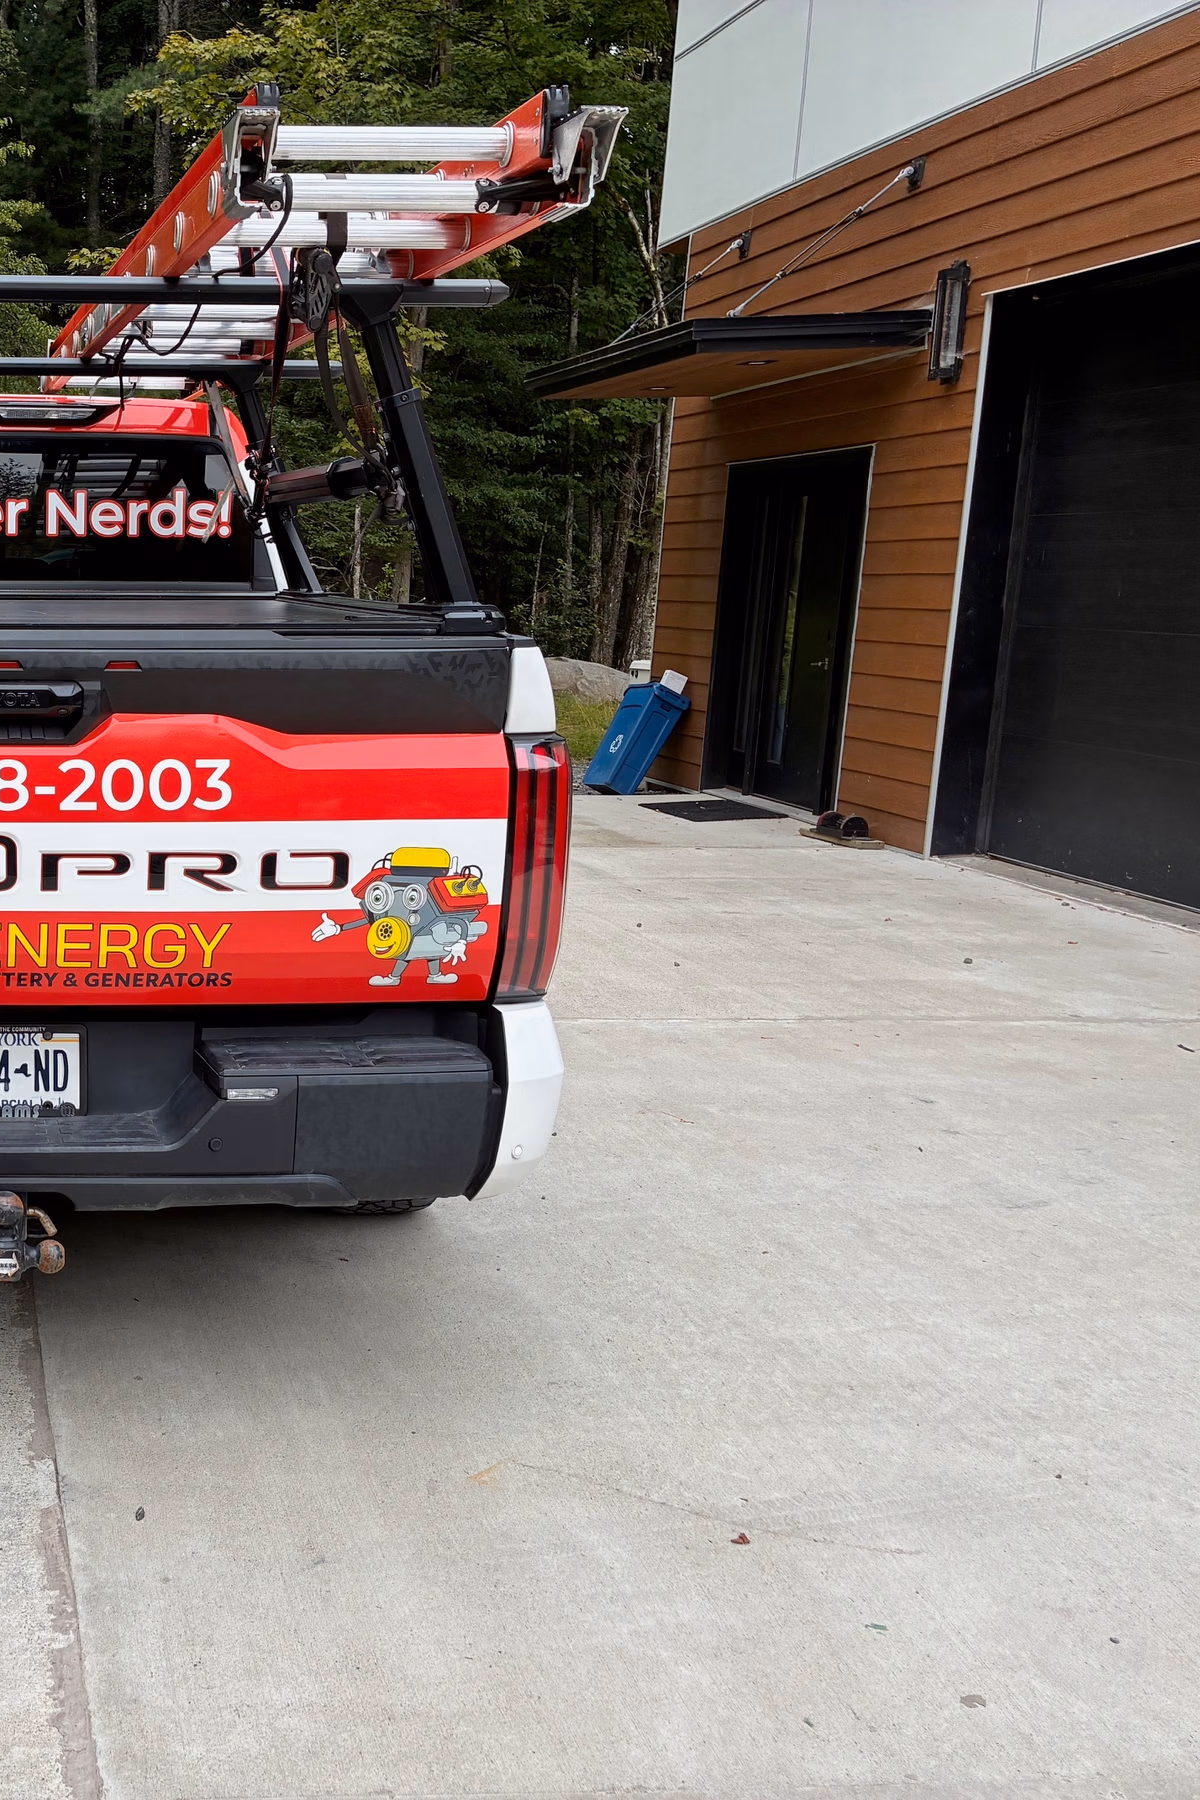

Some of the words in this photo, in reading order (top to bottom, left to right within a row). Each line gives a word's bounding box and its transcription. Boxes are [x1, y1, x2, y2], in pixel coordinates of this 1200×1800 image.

[45, 488, 234, 540] Nerds!
[62, 972, 78, 987] &
[84, 972, 233, 988] GENERATORS
